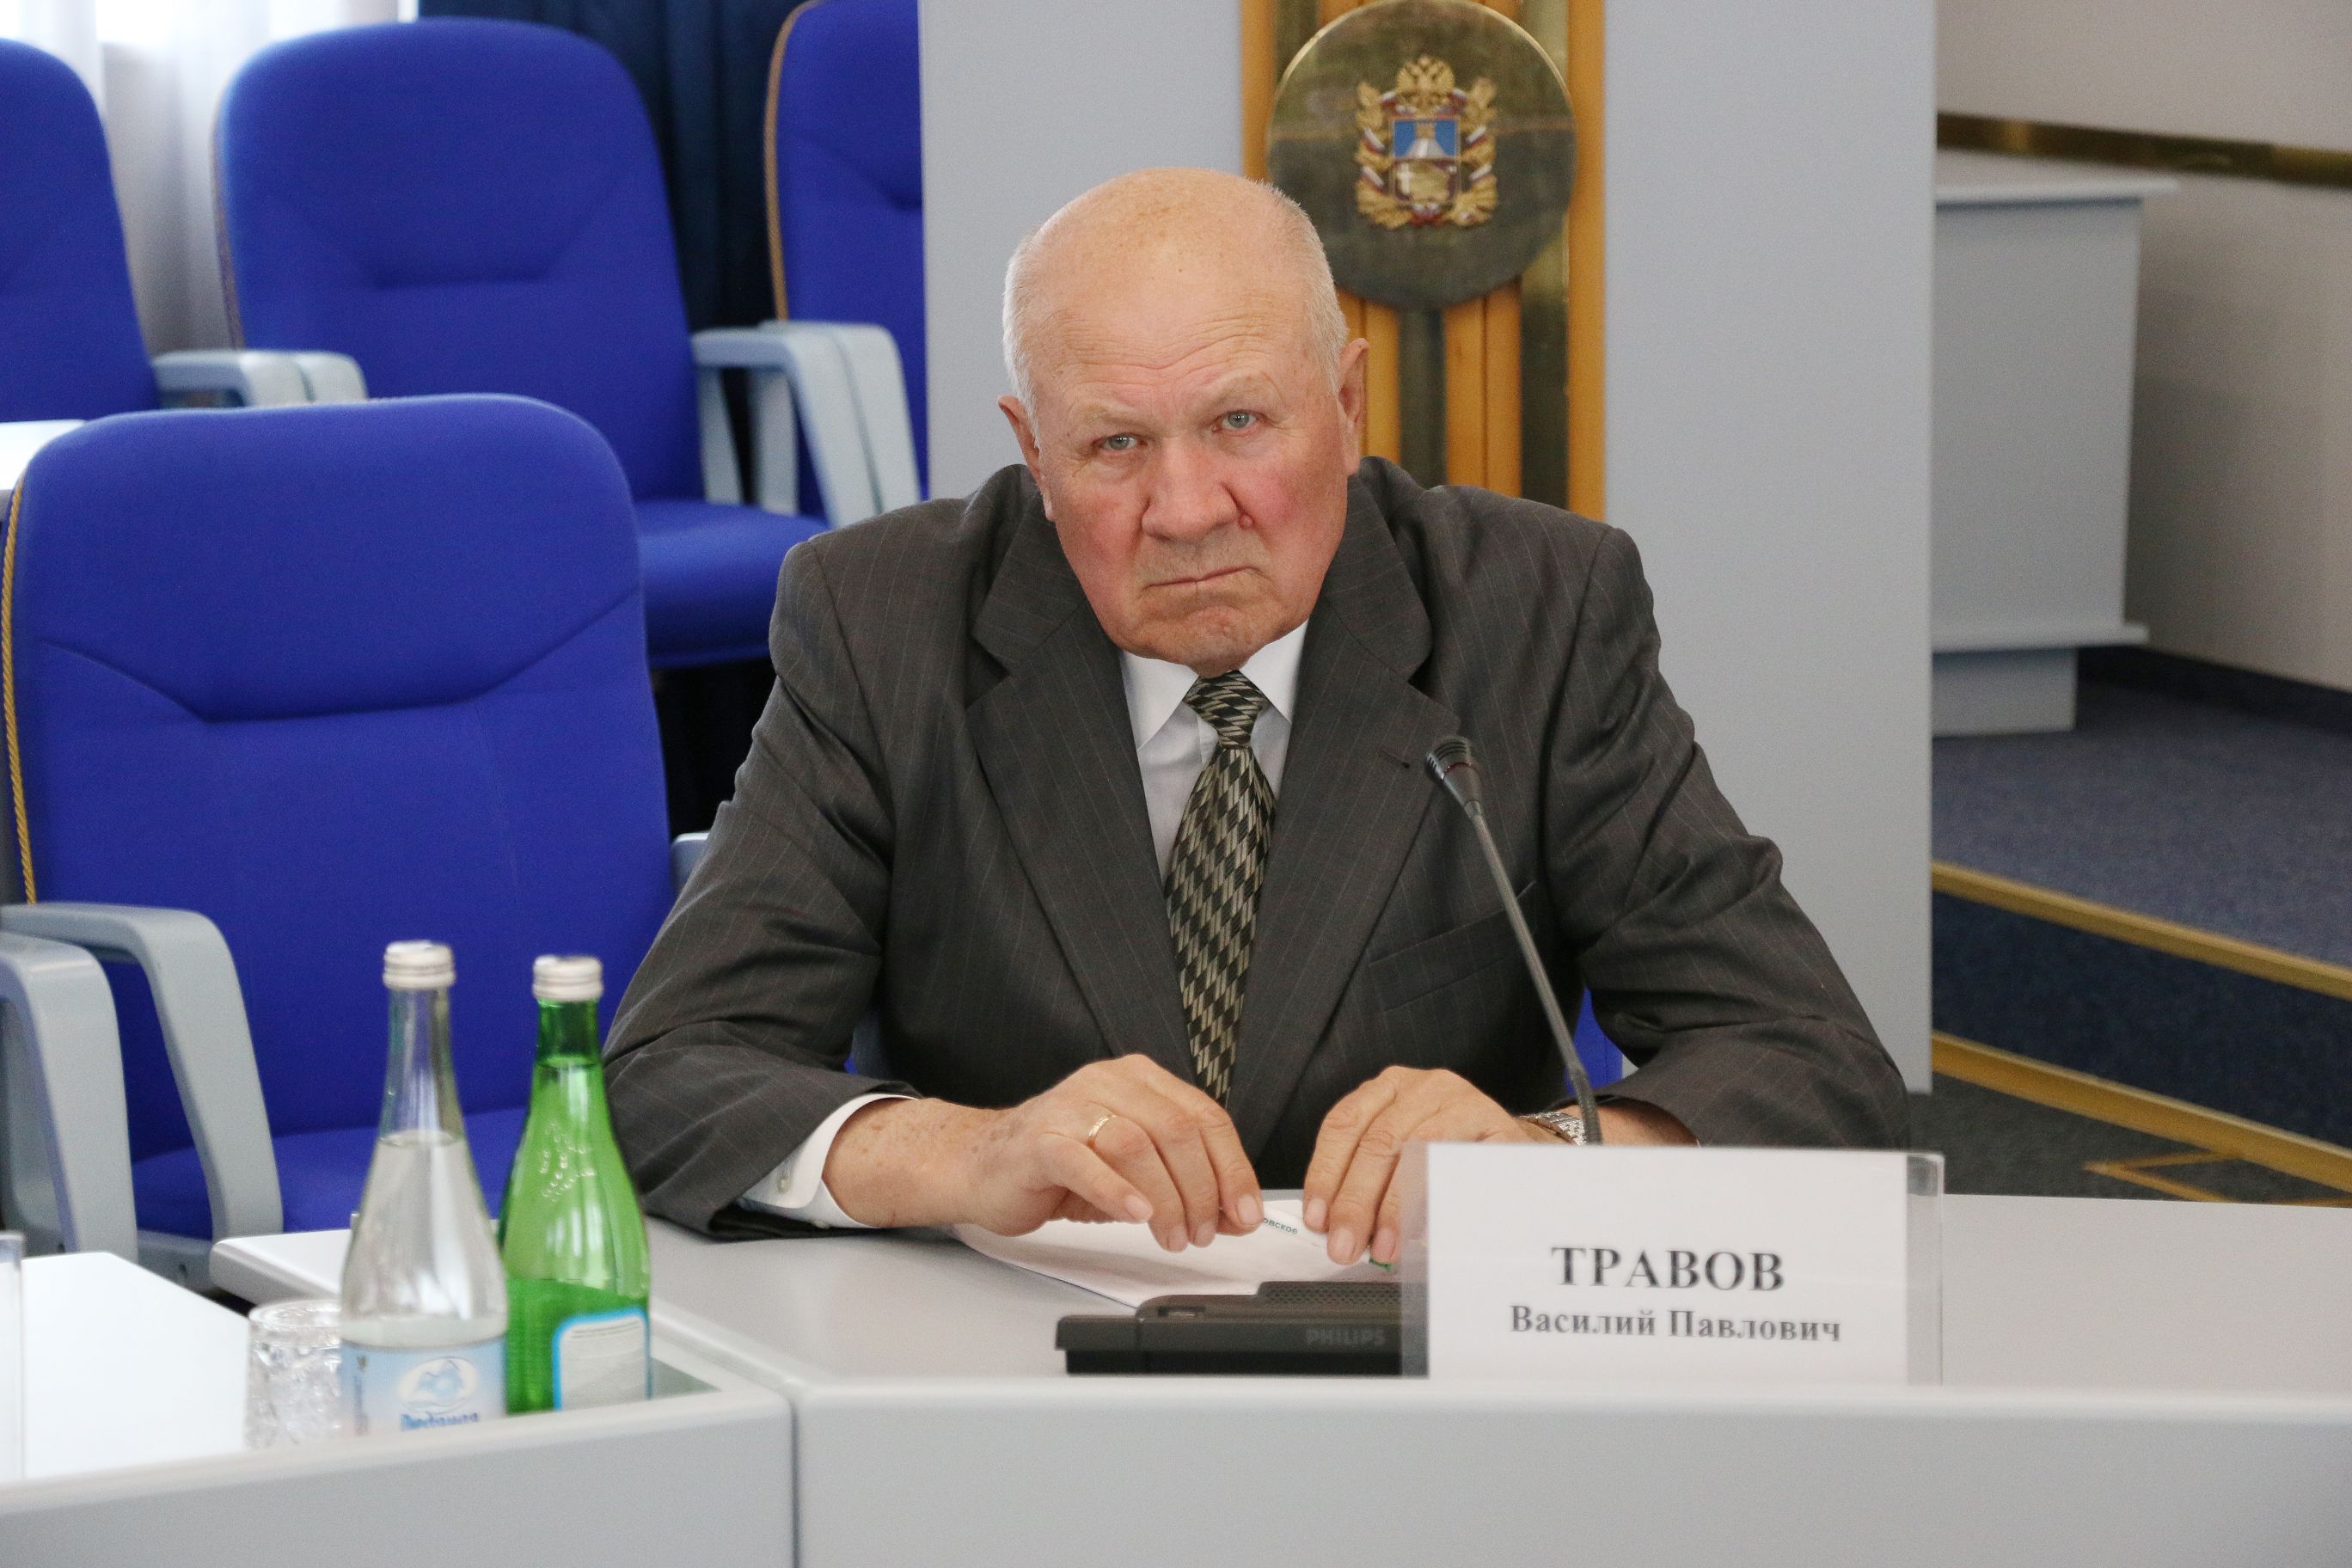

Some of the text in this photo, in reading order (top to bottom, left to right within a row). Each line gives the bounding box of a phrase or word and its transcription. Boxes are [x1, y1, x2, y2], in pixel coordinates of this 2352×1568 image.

[1551, 1246, 1785, 1291] ТРАВОВ
[1305, 1328, 1386, 1346] PHILIPS
[1510, 1304, 1841, 1342] Василий Павлович
